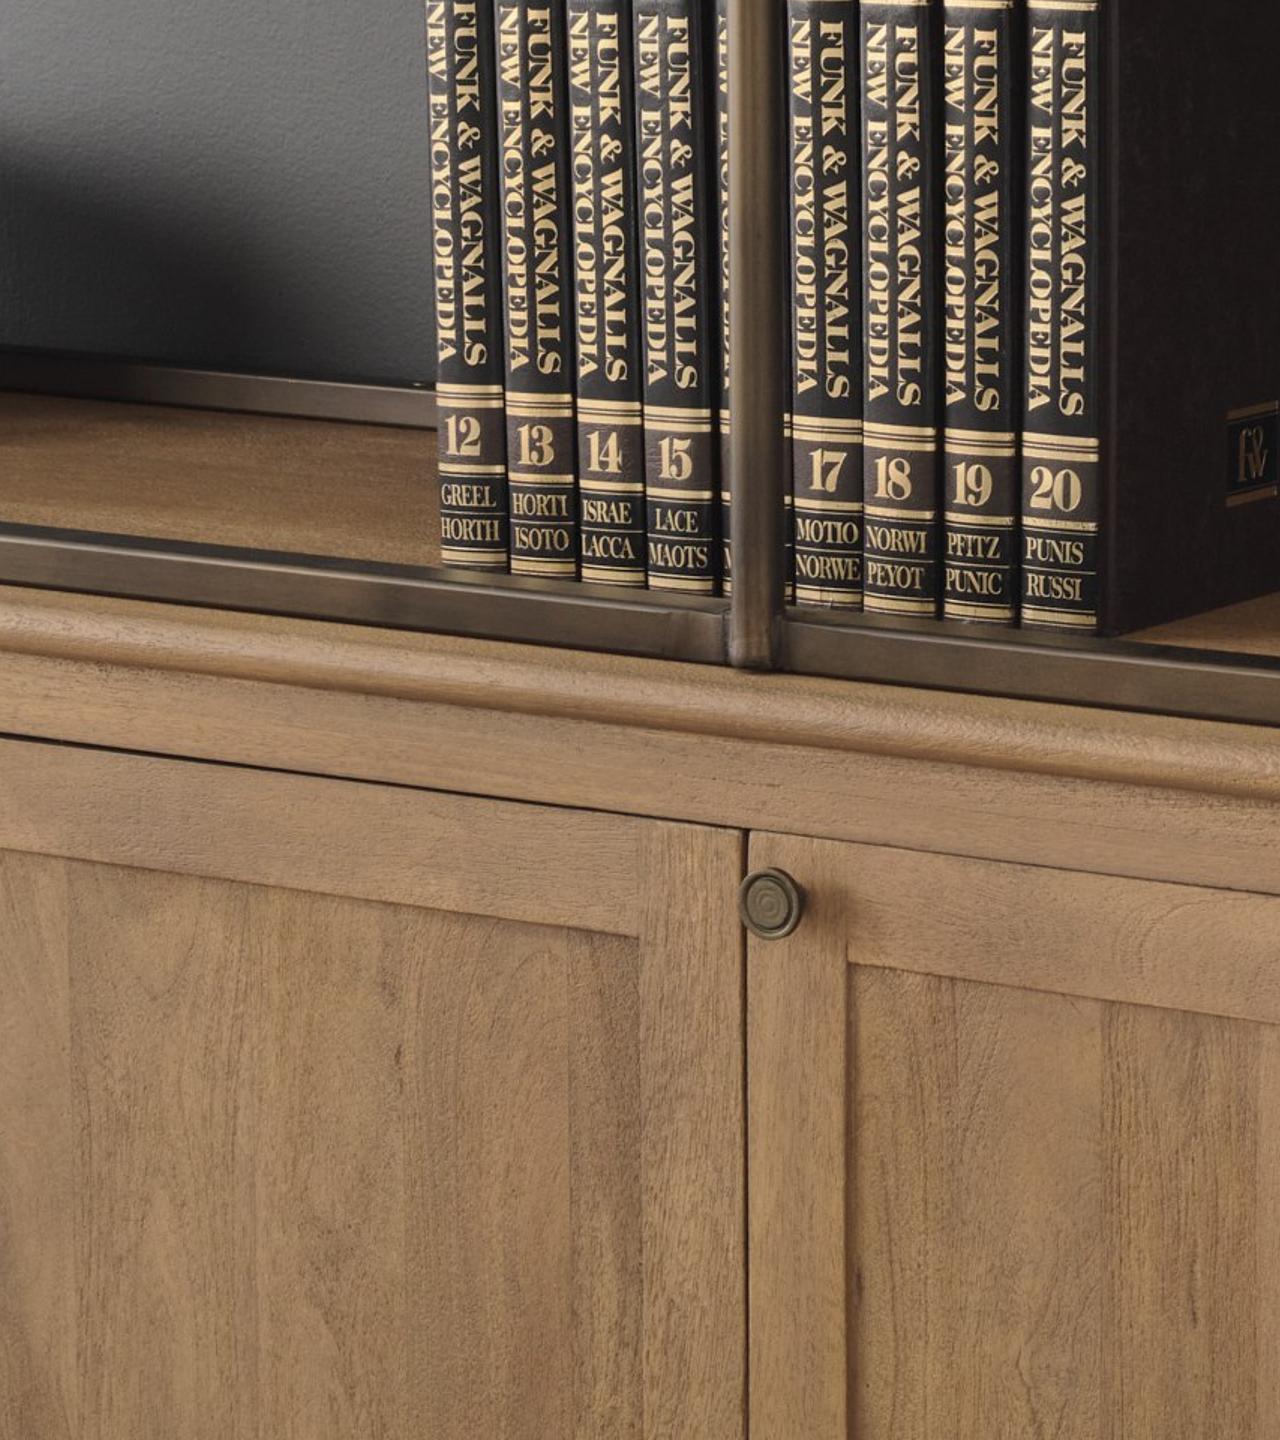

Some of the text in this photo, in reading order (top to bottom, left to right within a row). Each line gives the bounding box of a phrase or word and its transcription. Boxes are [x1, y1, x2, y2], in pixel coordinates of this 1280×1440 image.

[426, 0, 457, 363] NEW ENCYCLOPEDIA
[453, 1, 487, 367] FUNK & WAGNALLS
[499, 6, 529, 372] NEW ENCYCLOPEDIA
[527, 7, 561, 375] FUNK & WAGNALLS
[570, 11, 599, 379] NEW ENCYCLOPEDIA
[596, 12, 627, 383] FUNK & WAGNALLS
[638, 14, 668, 386] NEW ENCYCLOPEDIA
[666, 16, 698, 390] FUNK & WAGNALLS
[791, 19, 818, 395] NEW ENCYCLOPEDIA
[819, 20, 850, 398] FUNK & WAGNALLS
[865, 22, 889, 401] NEW ENCYCLOPEDIA
[895, 26, 922, 407] FUNK & WAGNALLS
[943, 26, 967, 406] NEW ENCYCLOPEDIA
[973, 28, 999, 412] FUNK & WAGNALLS
[1027, 26, 1054, 411] NEW ENCYCLOPEDIA
[1059, 30, 1087, 416] FUNK & WAGNALLS
[444, 415, 482, 457] 12
[517, 425, 555, 467] 13
[586, 430, 622, 473] 14
[658, 436, 693, 480] 15
[808, 448, 848, 493] 17
[874, 455, 912, 501] 18
[952, 461, 993, 507] 19
[1030, 465, 1082, 512] 20
[441, 483, 496, 508] GREEL
[512, 492, 568, 517] HORTI
[582, 498, 632, 525] ISRAE
[441, 517, 500, 542] HORTH
[515, 526, 569, 551] ISOTO
[655, 508, 698, 533] LACE
[796, 518, 859, 545] MOTIO
[866, 525, 927, 553] NORWI
[581, 533, 635, 559] LACCA
[649, 542, 708, 568] MAOTS
[795, 554, 861, 581] NORWE
[947, 533, 1001, 560] PFITZ
[1026, 536, 1084, 565] PUNIS
[867, 561, 924, 589] PEYOT
[946, 569, 1002, 596] PUNIC
[1027, 572, 1083, 601] RUSSI
